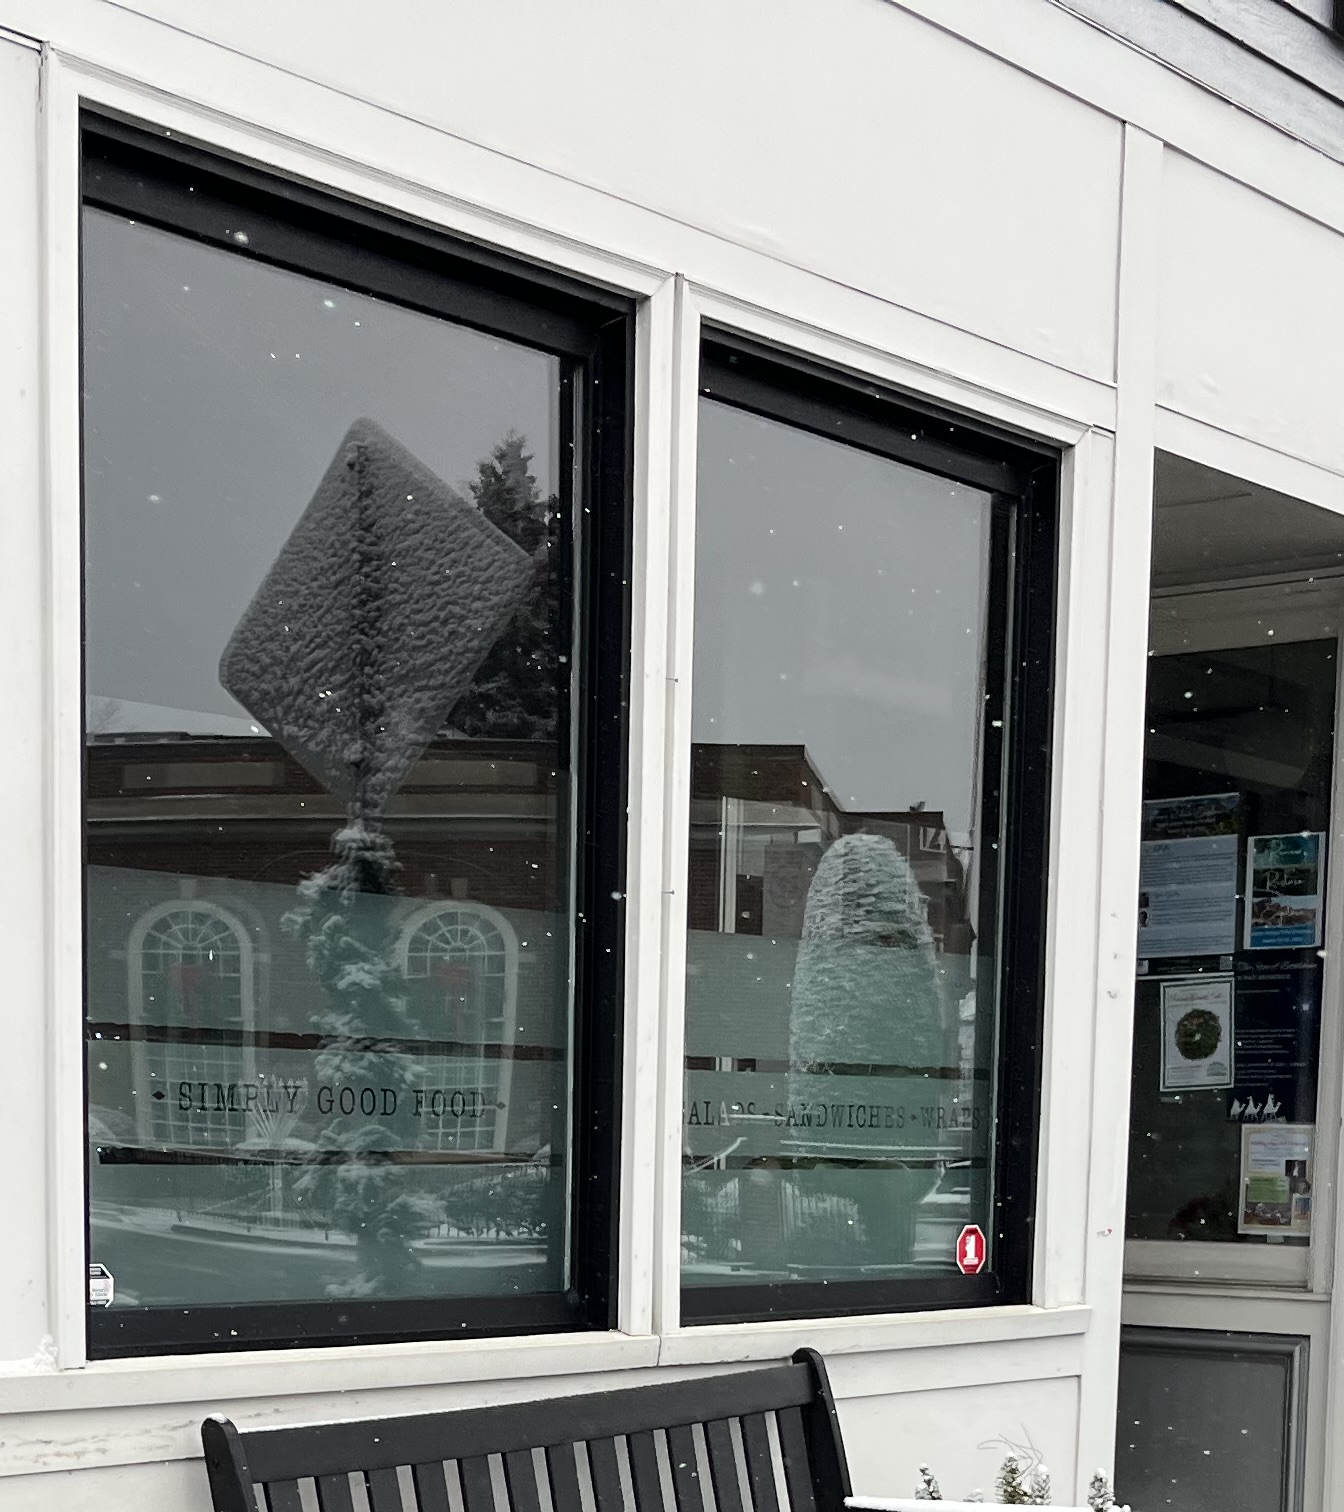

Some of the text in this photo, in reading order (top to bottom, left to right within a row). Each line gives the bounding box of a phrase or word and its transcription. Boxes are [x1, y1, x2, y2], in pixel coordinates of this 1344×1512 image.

[177, 1081, 487, 1119] SIMPLY GOOD FOOD
[684, 1100, 982, 1131] ALADS SANDWICHES WRAPS
